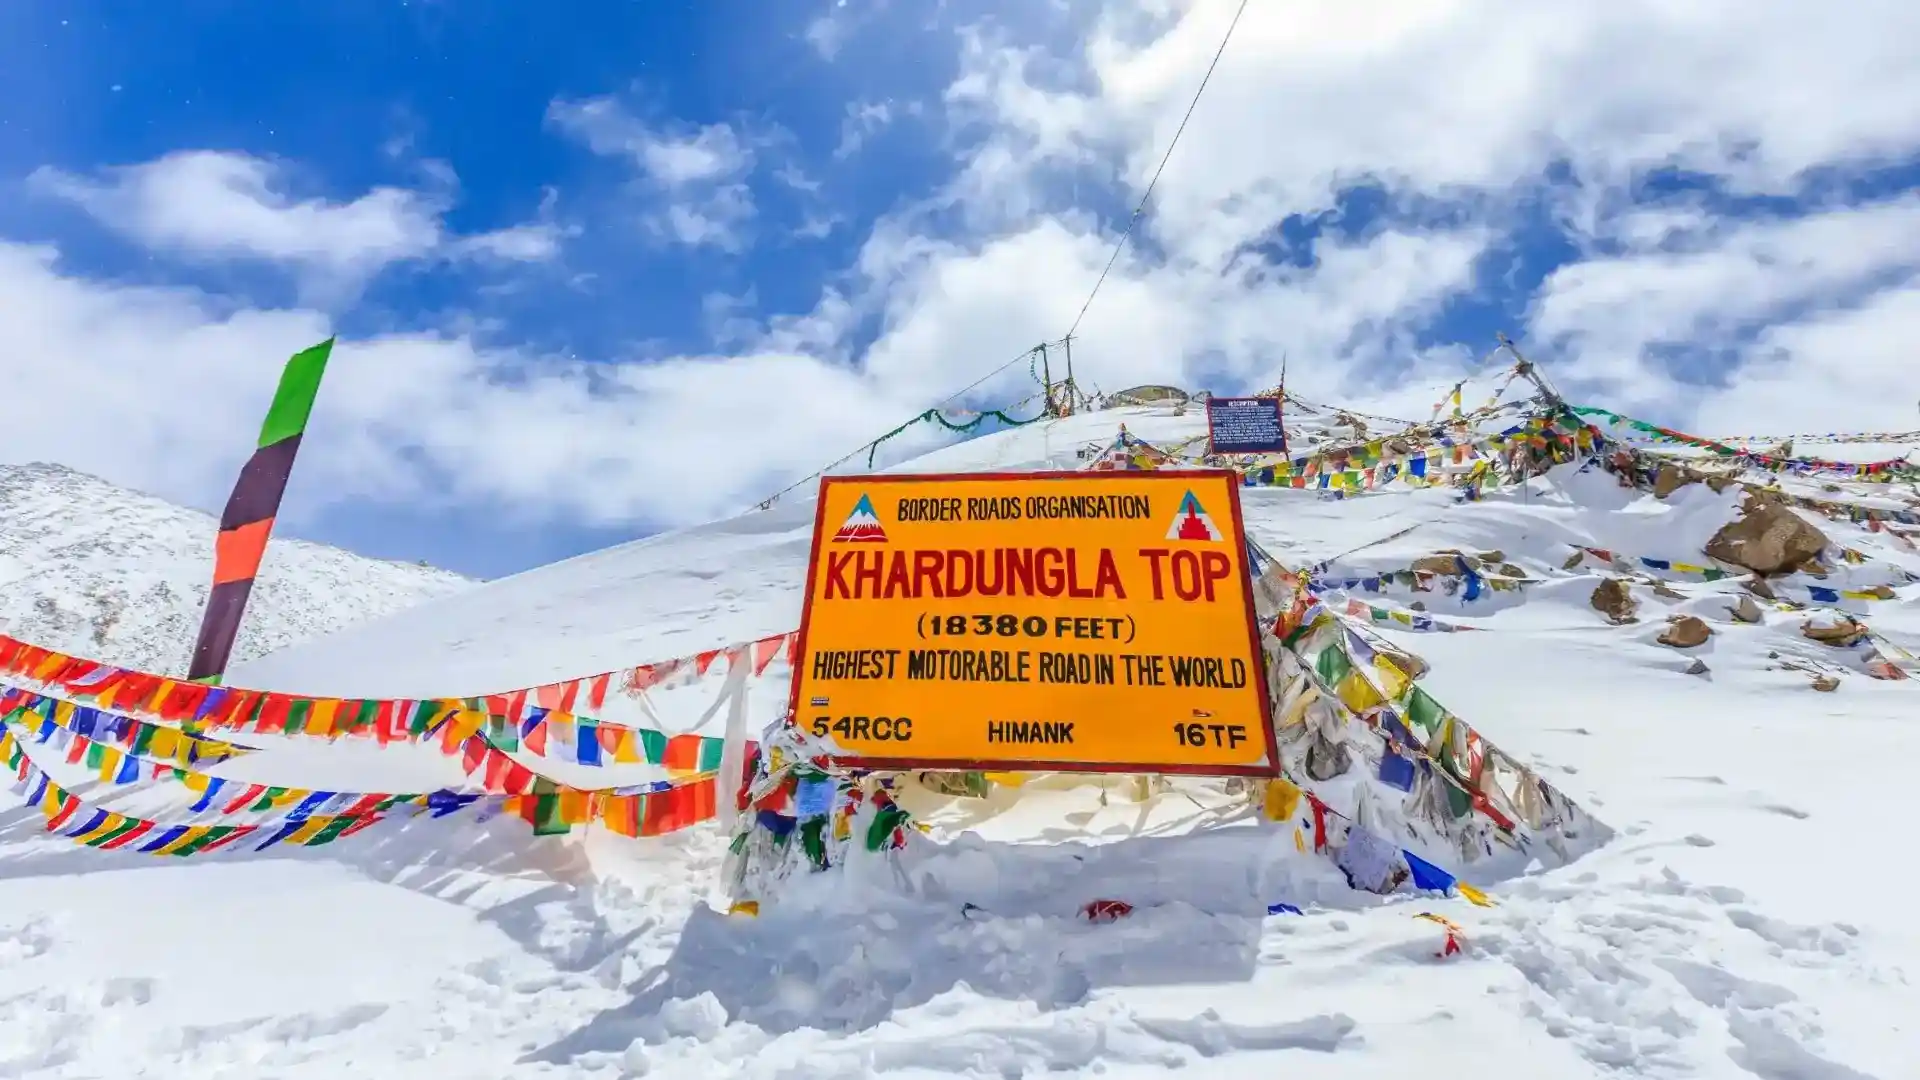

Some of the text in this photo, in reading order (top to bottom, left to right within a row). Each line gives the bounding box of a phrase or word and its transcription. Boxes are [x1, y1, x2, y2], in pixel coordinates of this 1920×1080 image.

[897, 494, 1151, 522] BORDER ROADS ORGANISATION
[824, 548, 1231, 603] KHARDUNGLA TOP
[1054, 614, 1136, 645] FEET)
[812, 649, 1247, 689] HIGHEST MOTORABLE ROAD IN THE WORLD
[811, 716, 913, 742] 54RCC
[988, 720, 1075, 744] HIMANK
[1173, 722, 1247, 749] 16TF
